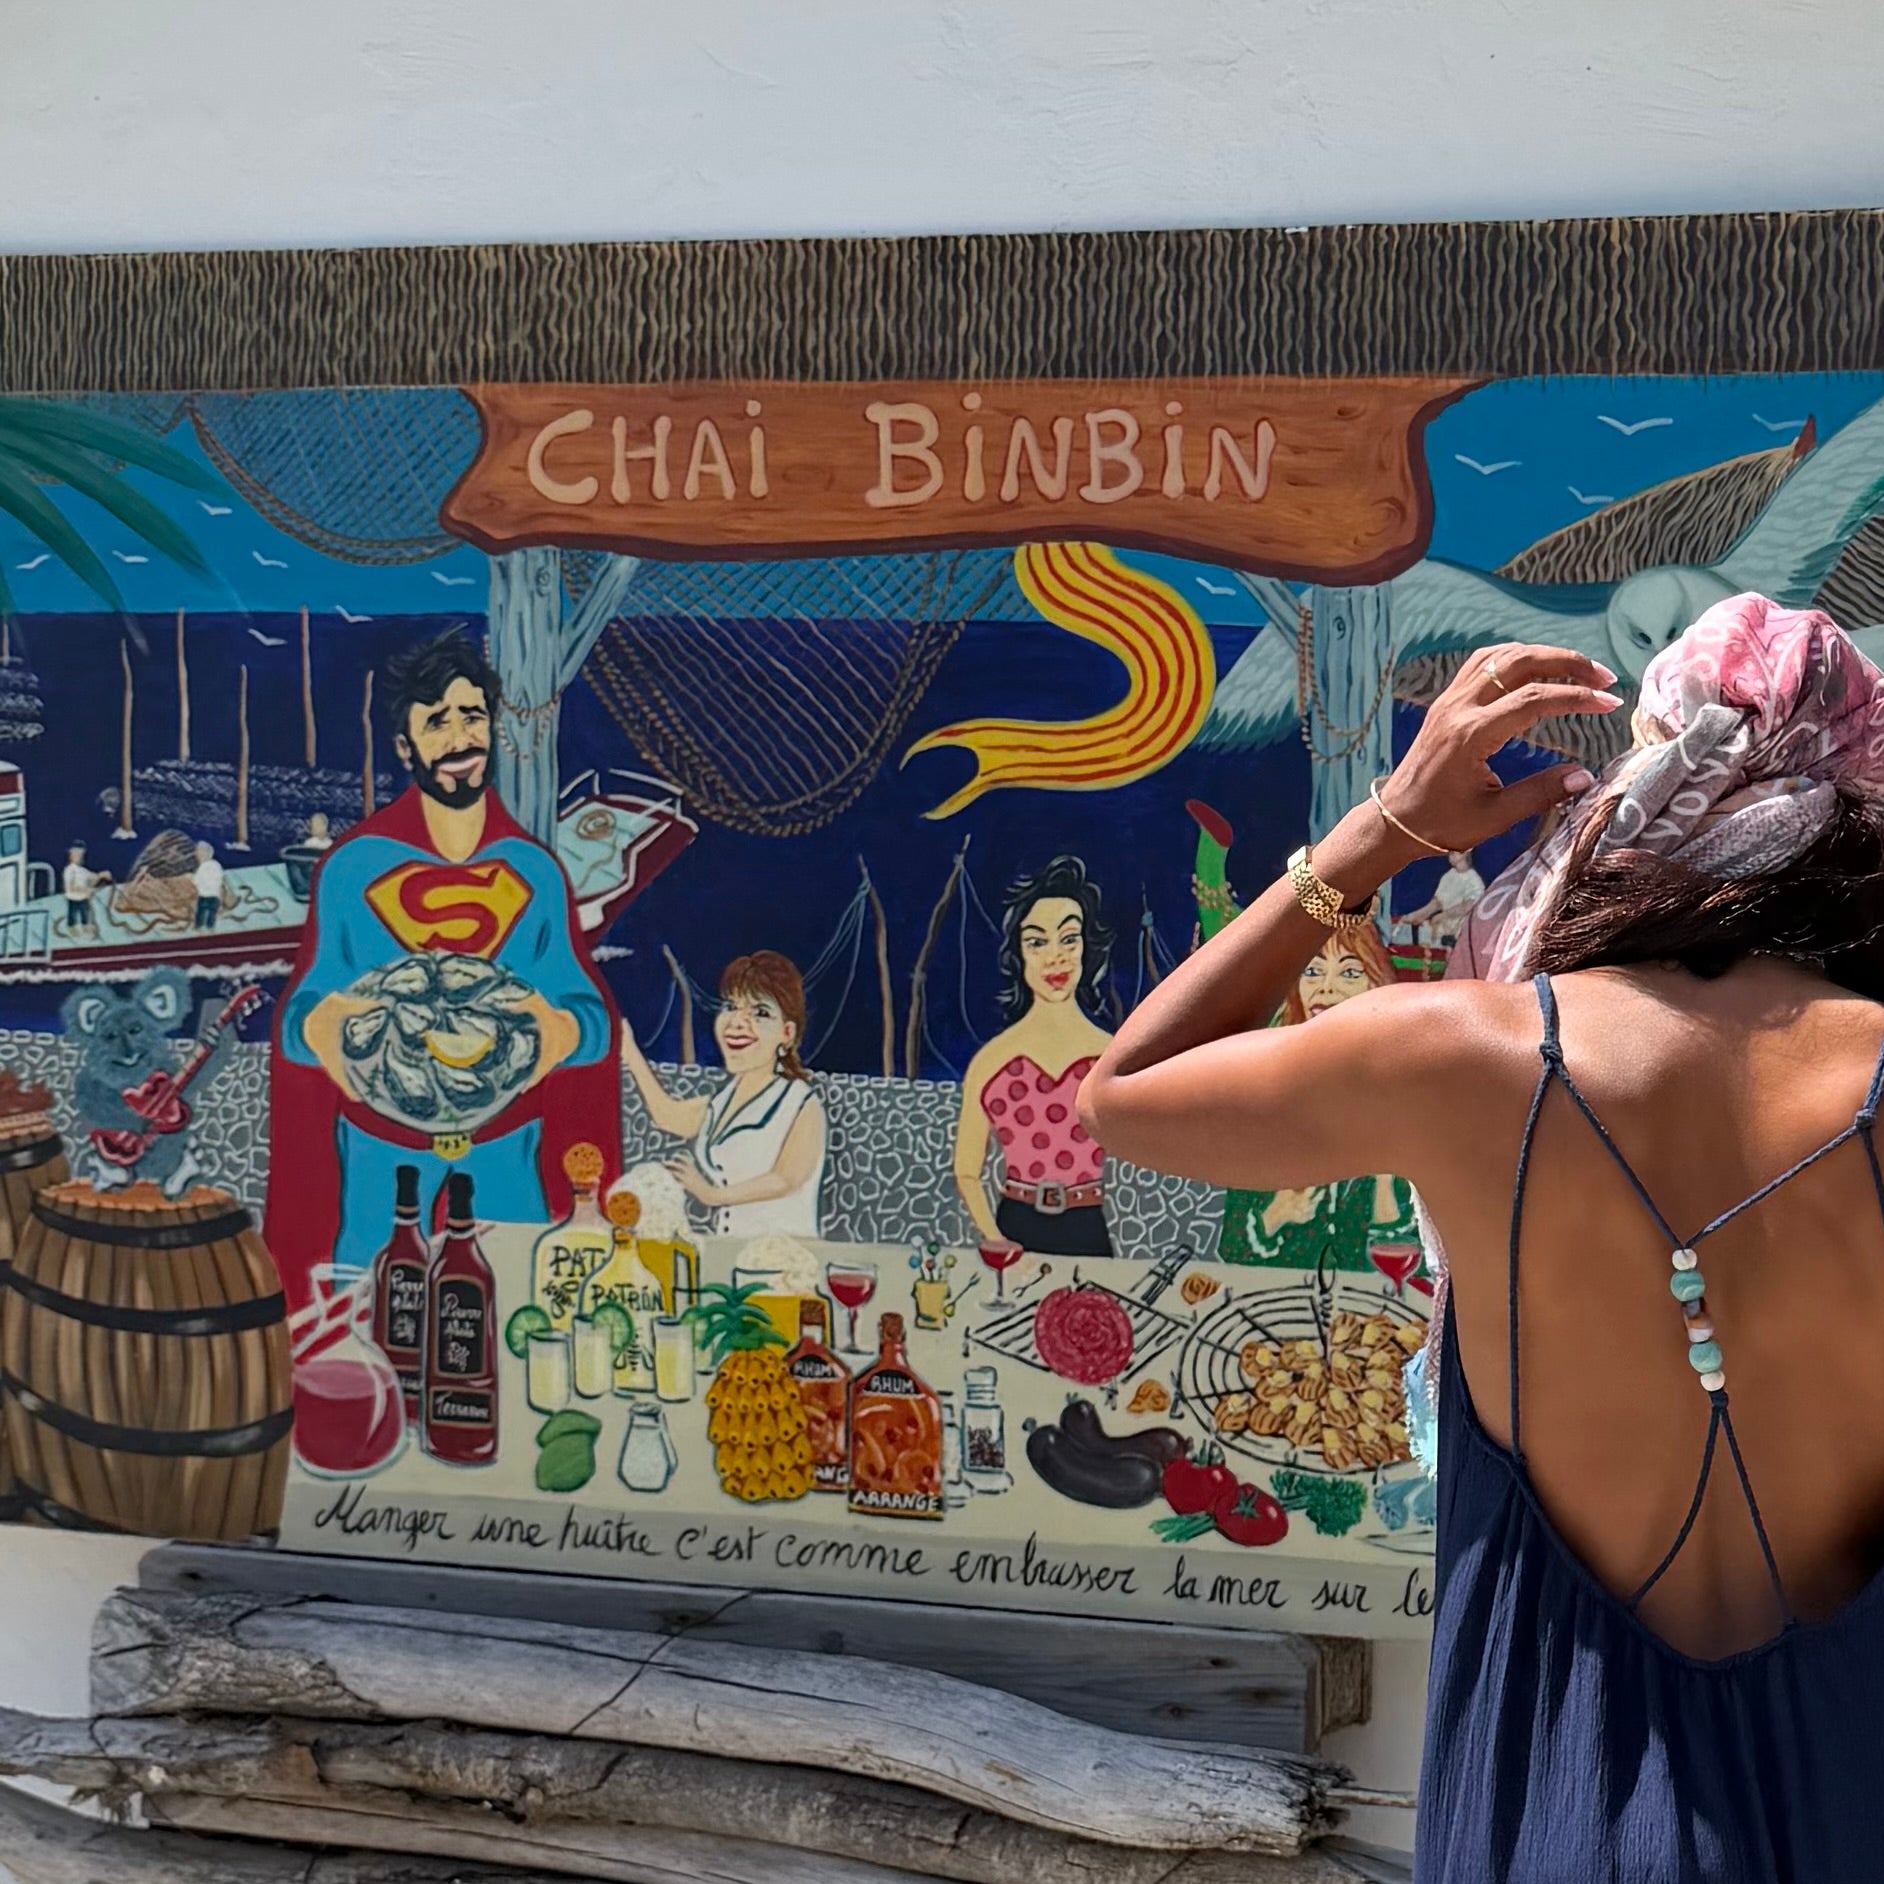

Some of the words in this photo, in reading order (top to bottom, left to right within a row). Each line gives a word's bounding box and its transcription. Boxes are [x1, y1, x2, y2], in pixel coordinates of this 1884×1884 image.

[400, 867, 500, 954] S
[550, 1246, 605, 1276] PAT
[871, 1375, 914, 1393] RHUM
[314, 1484, 456, 1551] Manger
[470, 1513, 549, 1548] une
[560, 1504, 660, 1556] huître
[949, 1530, 1141, 1593] embrasser
[1163, 1554, 1201, 1598] la
[1207, 1575, 1290, 1608] mer
[1311, 1580, 1372, 1612] sur
[1392, 1567, 1436, 1617] le
